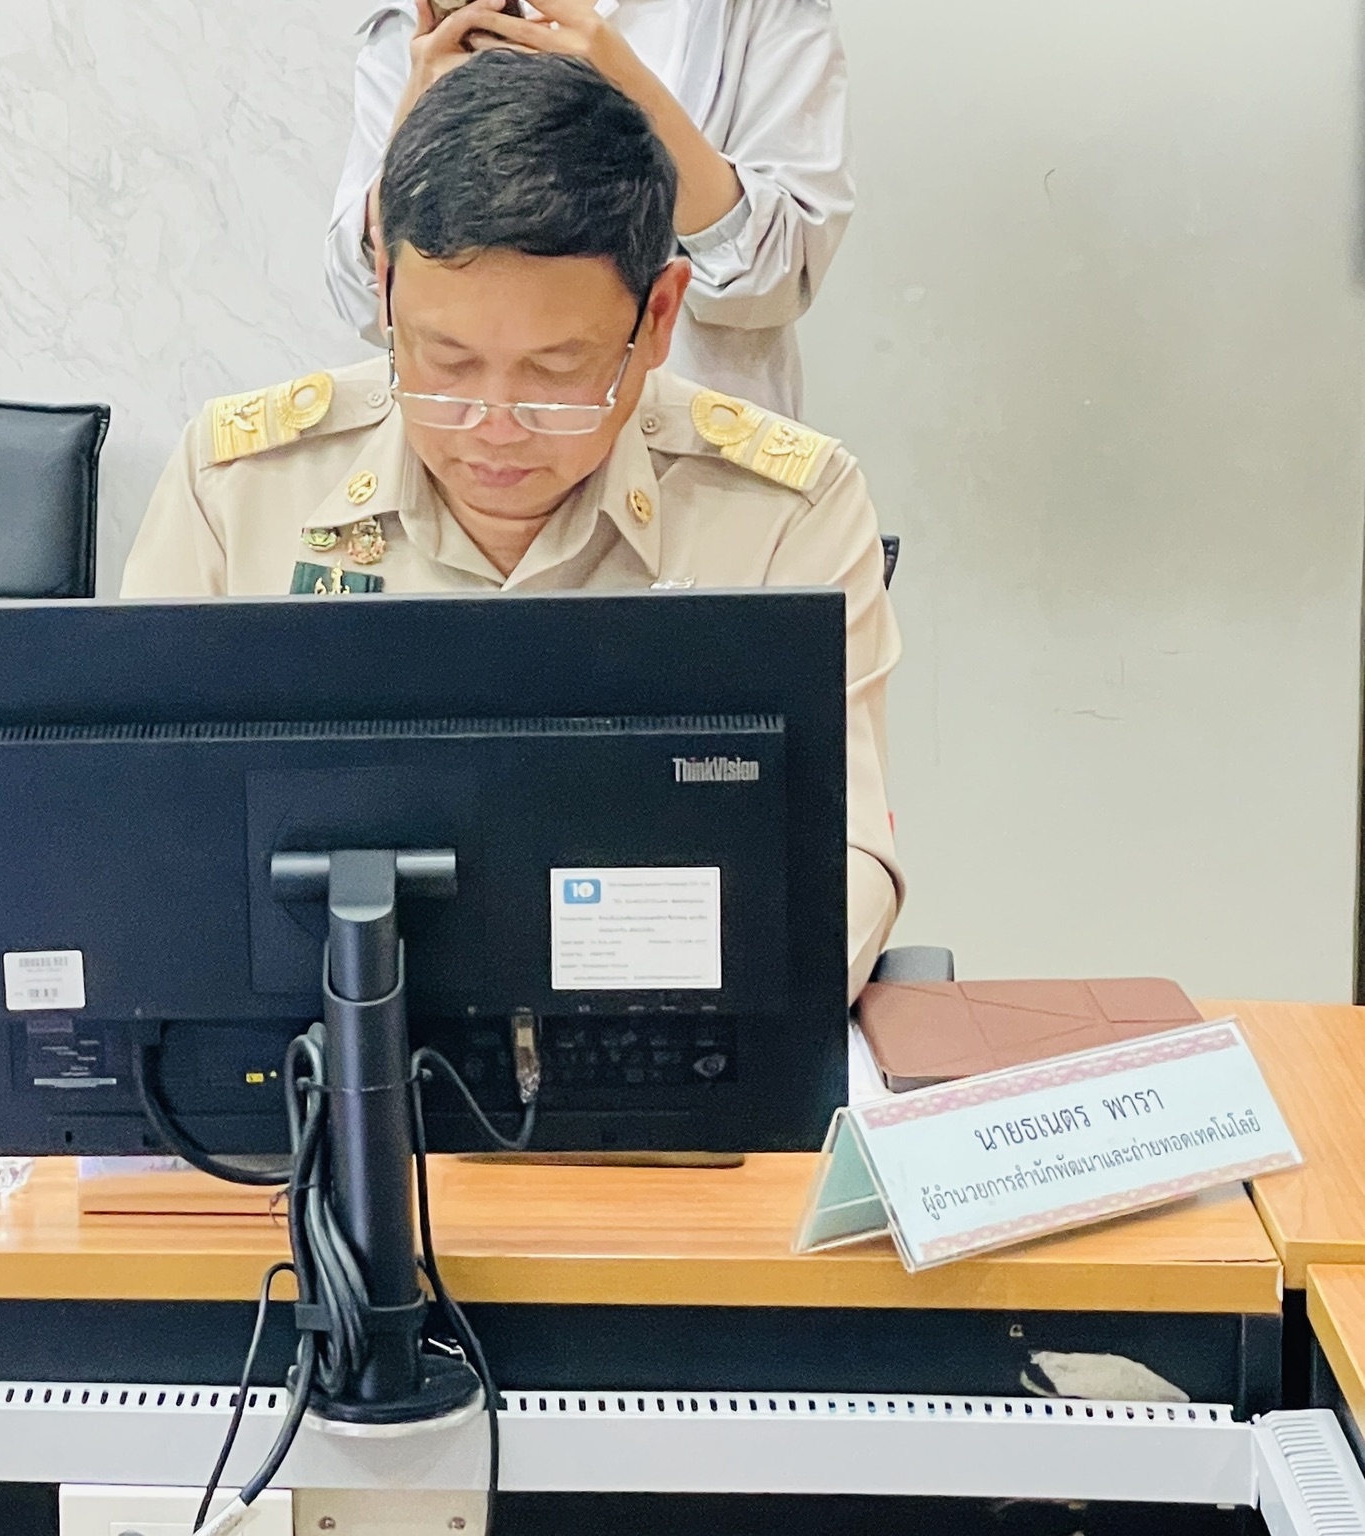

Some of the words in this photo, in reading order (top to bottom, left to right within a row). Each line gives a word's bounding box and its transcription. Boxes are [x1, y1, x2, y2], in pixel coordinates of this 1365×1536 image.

[671, 756, 760, 782] ThinkVision
[974, 1104, 1092, 1151] นายธเนตร
[1102, 1088, 1165, 1121] พารา
[921, 1109, 1262, 1221] ผู้อำนวยการสำนักพัฒนาและถ่ายทอดเทคโนโลยี
